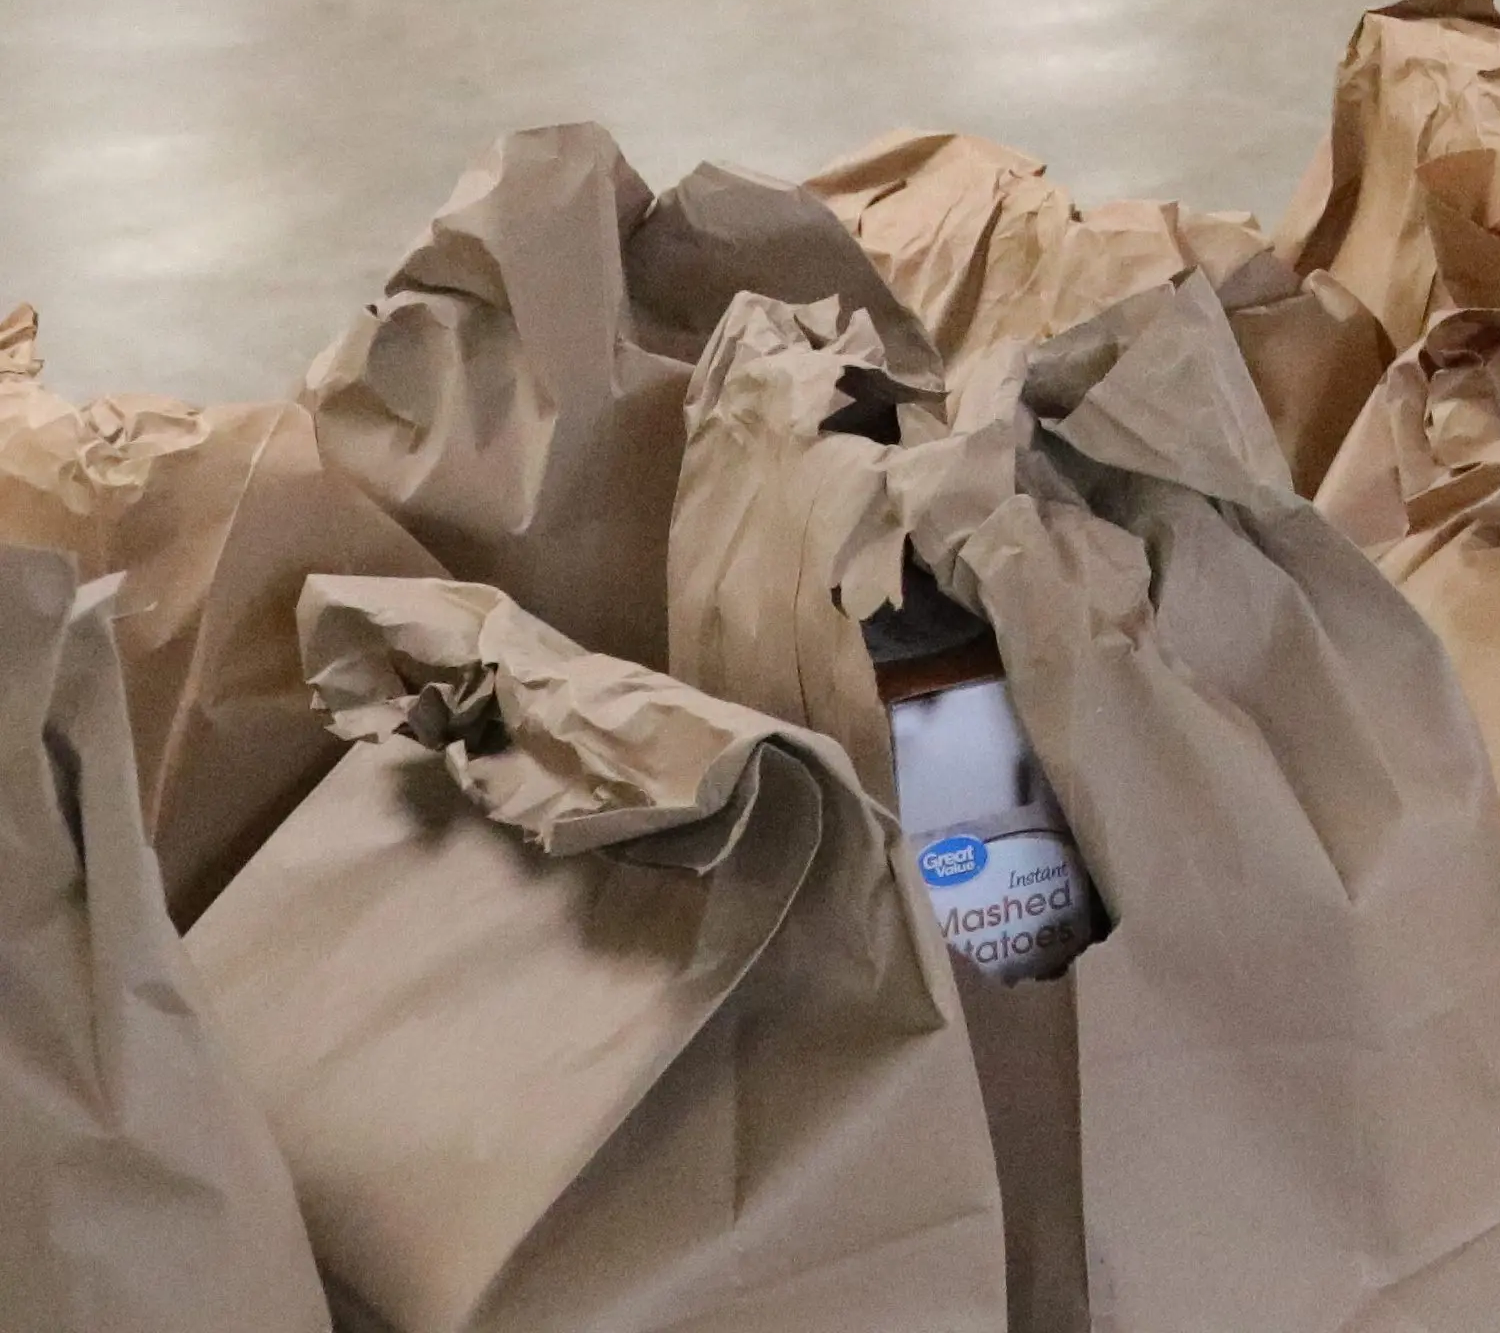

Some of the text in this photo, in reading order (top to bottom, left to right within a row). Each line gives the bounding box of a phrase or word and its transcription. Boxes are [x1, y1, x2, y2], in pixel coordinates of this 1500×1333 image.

[923, 844, 975, 871] Great
[934, 862, 975, 878] Value
[1008, 861, 1069, 890] Instant
